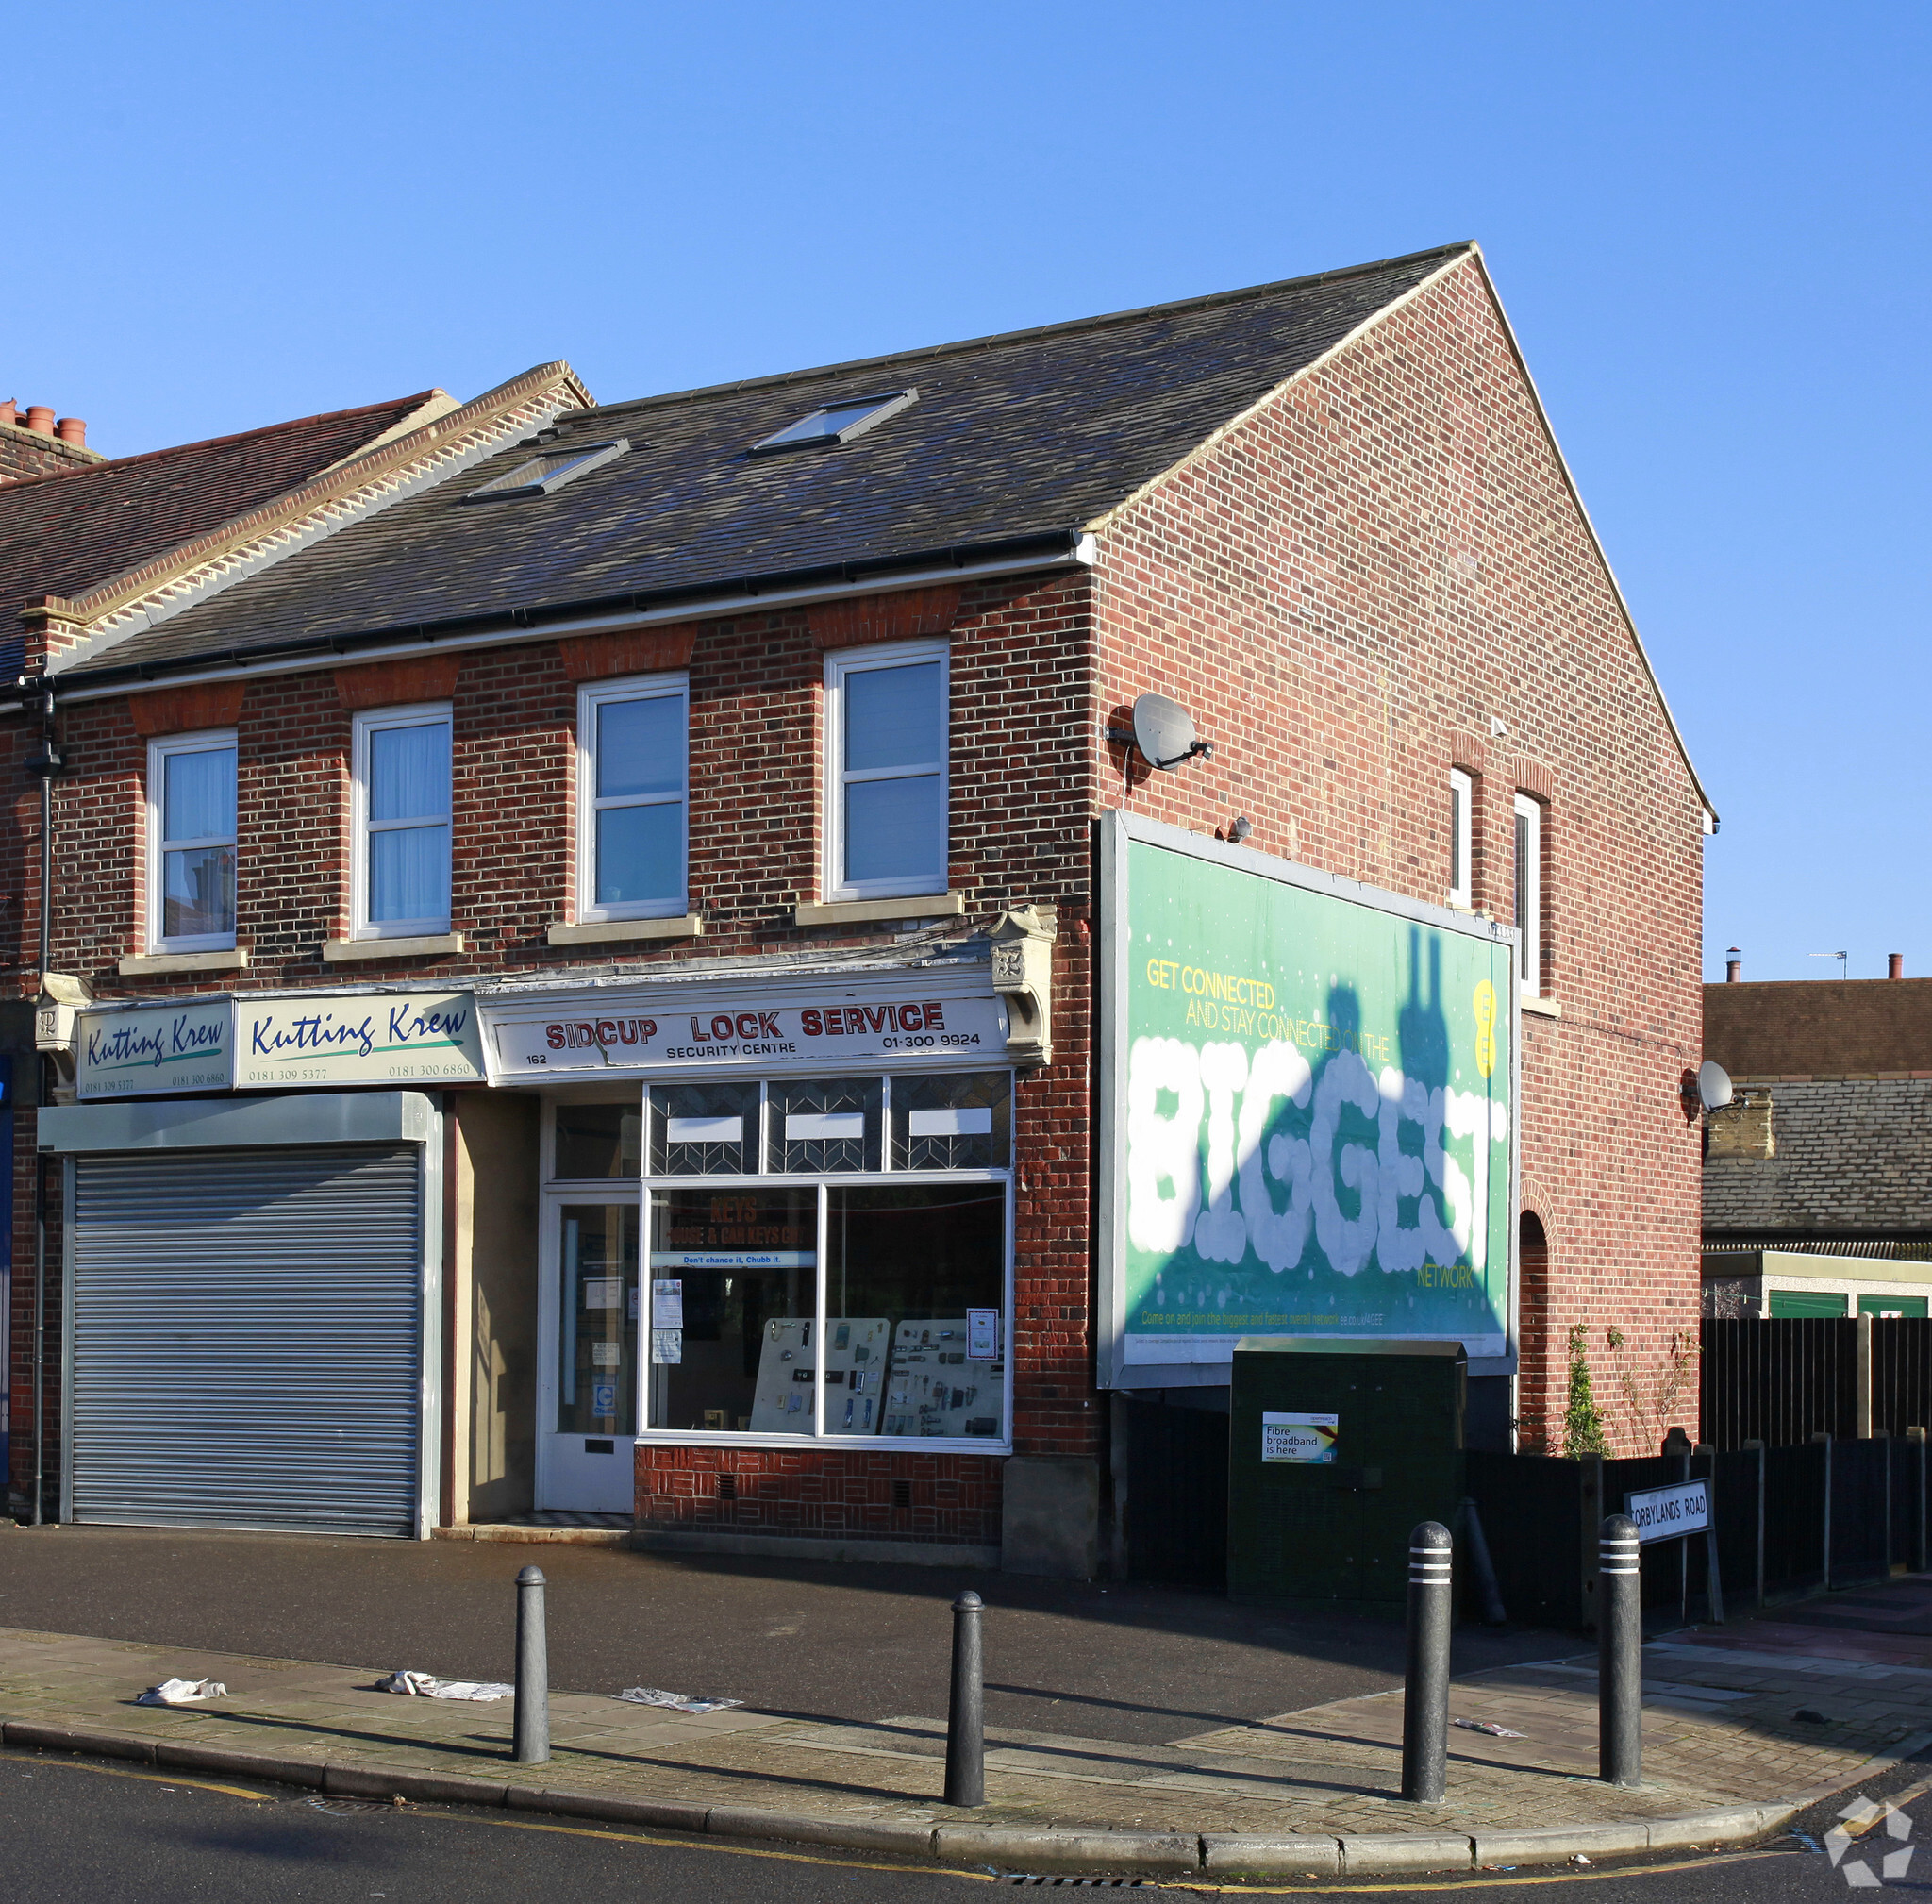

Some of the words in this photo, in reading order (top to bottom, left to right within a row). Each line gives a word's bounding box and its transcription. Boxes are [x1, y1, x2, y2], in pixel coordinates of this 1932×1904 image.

[1146, 958, 1180, 991] GET
[1181, 965, 1274, 1010] CONNECTED
[252, 1013, 376, 1057] Kutting
[389, 1002, 467, 1043] Krew
[545, 1019, 658, 1049] SIDCUP
[691, 1011, 784, 1043] LOCK
[801, 1002, 945, 1036] SERVICE
[1186, 998, 1219, 1029] AND
[1221, 1005, 1256, 1036] STAY
[1257, 1012, 1341, 1051] CONNECTED
[1341, 1029, 1363, 1054] ON
[1364, 1033, 1390, 1061] THE
[88, 1026, 165, 1067] Kutting
[172, 1014, 224, 1054] Krew
[941, 1033, 981, 1046] 9924
[666, 1044, 738, 1059] SECURITY
[742, 1042, 796, 1055] CENTRE
[526, 1055, 546, 1065] 162
[248, 1070, 274, 1081] 0181
[279, 1069, 297, 1080] 309
[302, 1068, 327, 1079] 5377
[389, 1065, 414, 1077] 0181
[420, 1064, 440, 1076] 300
[442, 1063, 470, 1075] 6860
[85, 1082, 101, 1093] 0181
[104, 1080, 116, 1092] 309
[118, 1079, 134, 1091] 5377
[173, 1076, 189, 1086] 0181
[192, 1074, 205, 1084] 300
[206, 1072, 225, 1083] 6860
[1128, 1036, 1507, 1277] BIGGEST
[710, 1196, 757, 1223] KEYS
[708, 1226, 717, 1244] &
[721, 1226, 745, 1244] CAR
[747, 1226, 780, 1244] KEYS
[1417, 1262, 1474, 1288] NETWORK
[1141, 1311, 1163, 1325] Come
[1165, 1313, 1175, 1325] on
[1177, 1311, 1191, 1325] and
[1191, 1311, 1206, 1328] join
[1208, 1311, 1221, 1325] the
[1222, 1311, 1249, 1328] biggest
[1250, 1312, 1263, 1325] and
[1265, 1311, 1288, 1325] fastest
[1290, 1311, 1311, 1325] overall
[1312, 1313, 1339, 1325] network
[1267, 1426, 1291, 1435] Fibre
[1266, 1436, 1318, 1445] broadband
[1266, 1445, 1274, 1454] is
[1276, 1445, 1297, 1455] here
[1684, 1495, 1706, 1517] ROAD
